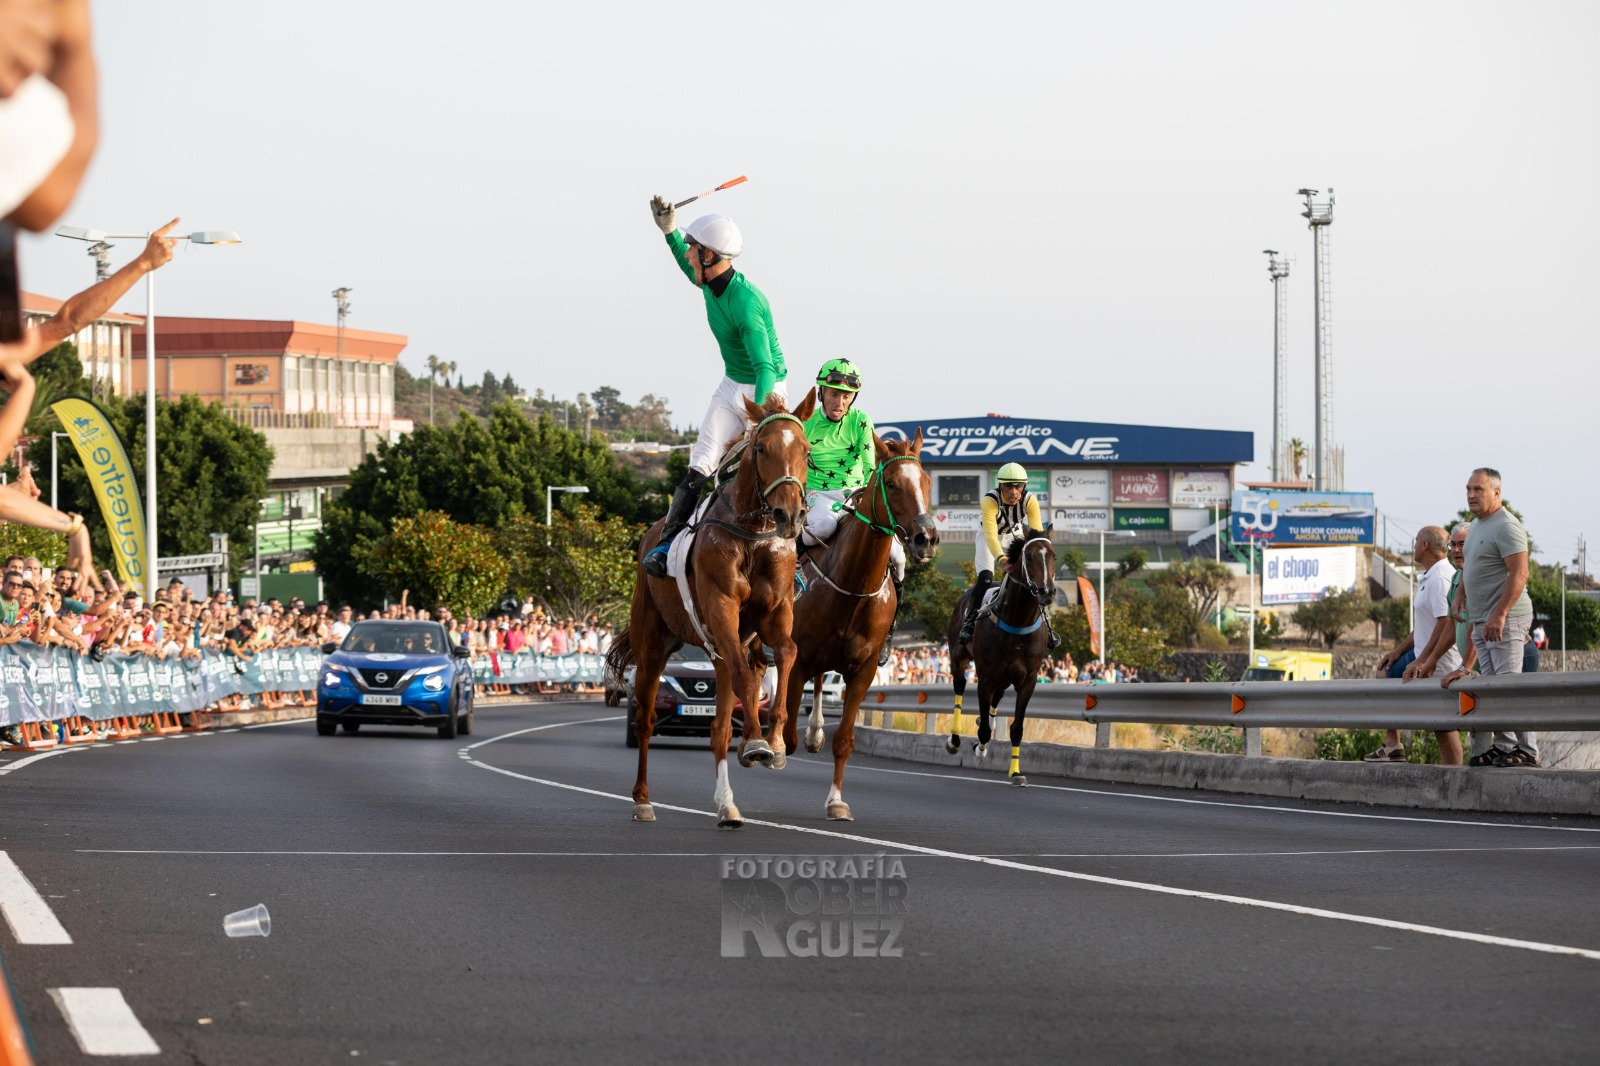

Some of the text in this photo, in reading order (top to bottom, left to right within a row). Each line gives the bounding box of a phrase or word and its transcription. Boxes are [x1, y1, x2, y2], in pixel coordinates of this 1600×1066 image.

[926, 424, 1053, 437] Centro Médico
[1083, 453, 1120, 461] Salud
[1238, 496, 1278, 532] 50
[1128, 516, 1165, 525] cajasiete
[1300, 527, 1325, 535] MEJOR
[1326, 526, 1365, 535] COMPAÑÍA
[1268, 556, 1279, 580] el
[1283, 555, 1319, 581] chopo
